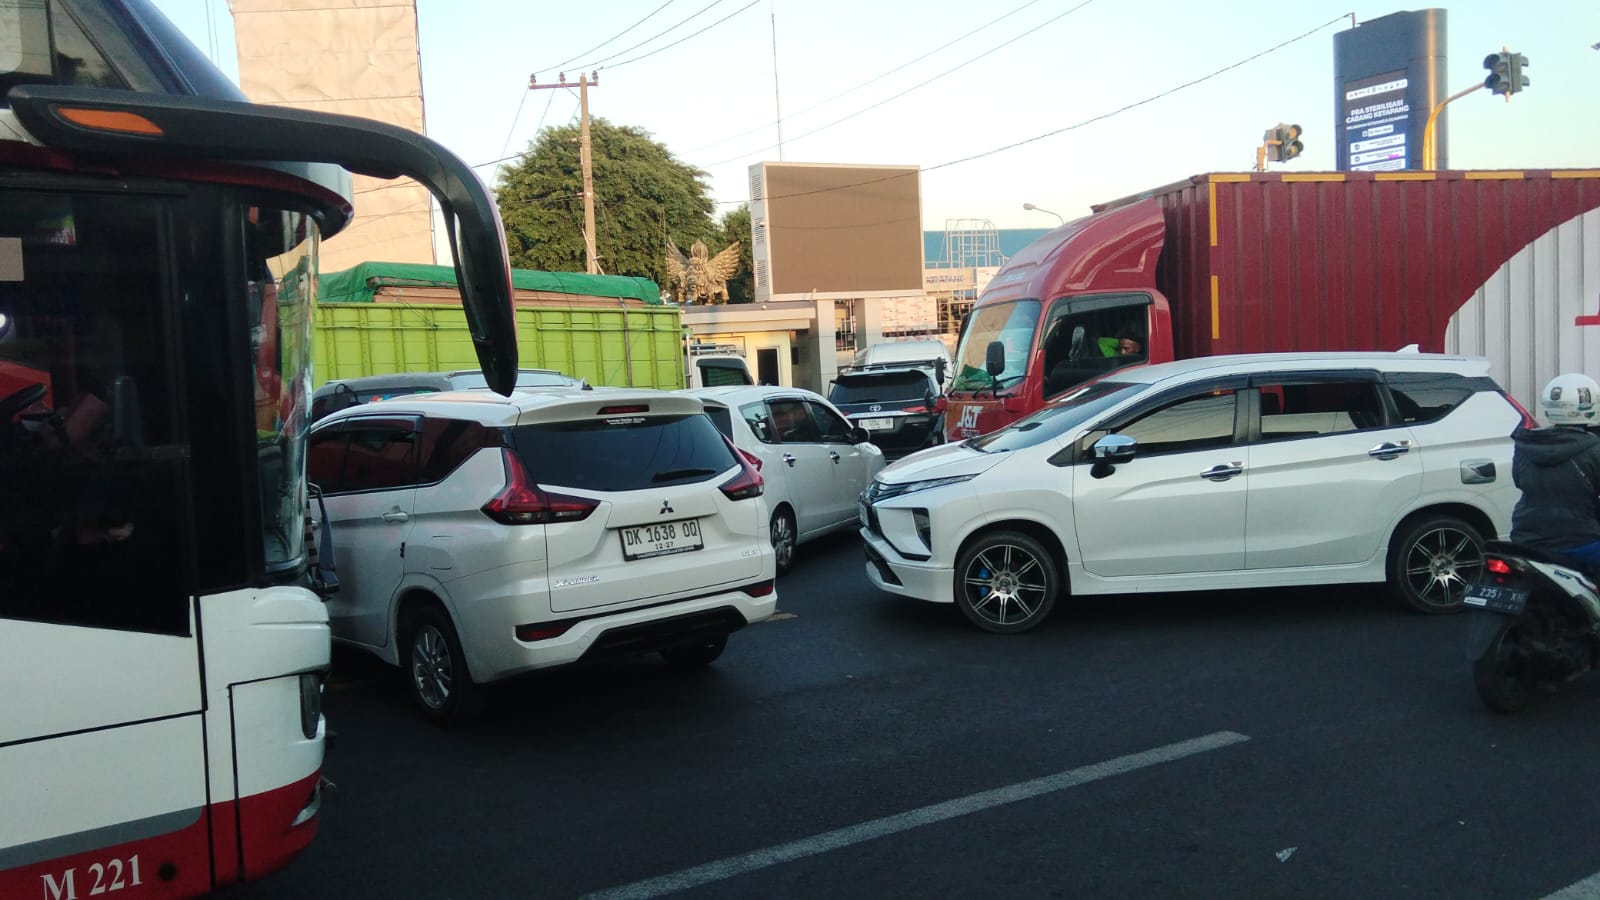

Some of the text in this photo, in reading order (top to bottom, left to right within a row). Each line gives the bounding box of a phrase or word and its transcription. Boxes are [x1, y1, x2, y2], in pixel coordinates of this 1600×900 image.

[1346, 112, 1373, 123] CABANG
[1374, 105, 1409, 118] KETAPANG
[1351, 99, 1403, 116] PRA STERILISASI
[956, 405, 984, 428] J&T
[625, 529, 642, 546] DK
[646, 525, 676, 543] 1638
[40, 854, 144, 900] M 221
